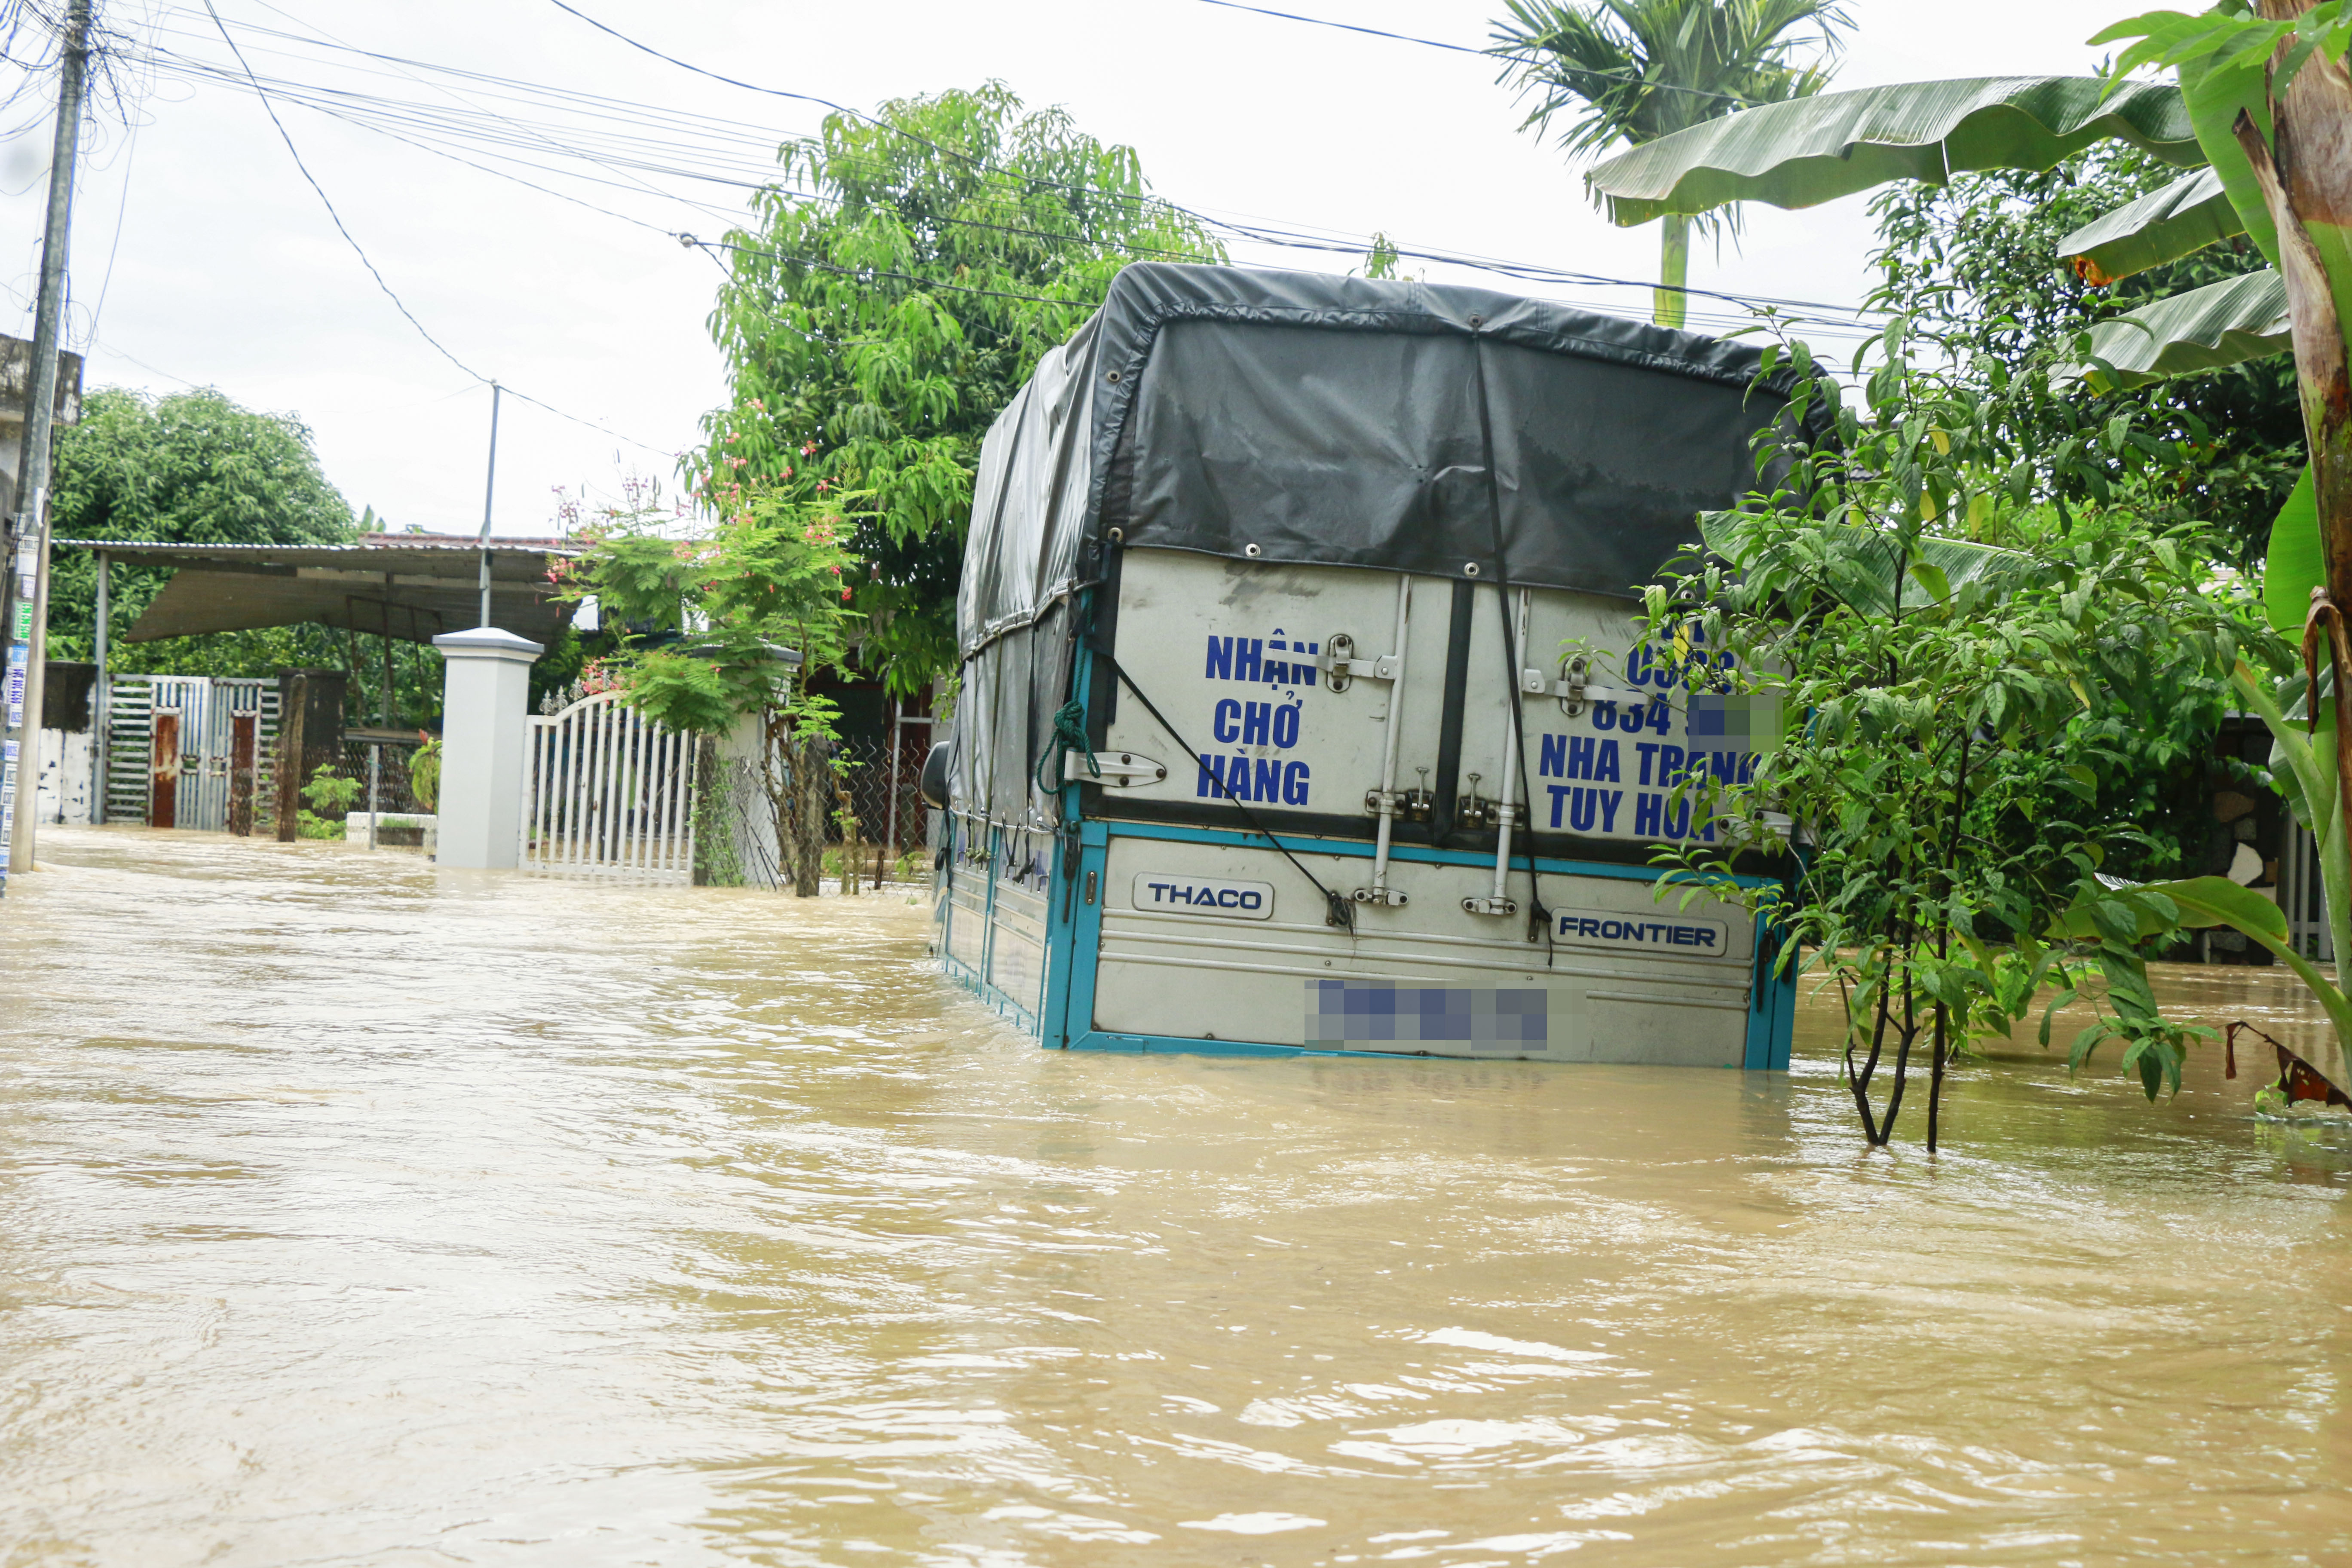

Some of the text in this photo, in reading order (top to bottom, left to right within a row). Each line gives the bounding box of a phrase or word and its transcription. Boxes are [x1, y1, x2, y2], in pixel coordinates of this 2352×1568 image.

[1206, 628, 1318, 690] NHẬN
[1213, 690, 1303, 749] CHỞ
[1592, 686, 1671, 736] 834
[1197, 748, 1310, 805] HÀNG
[1539, 733, 1620, 783] NHA
[1547, 784, 1623, 833] TUY
[1148, 882, 1262, 910] THACO
[1559, 916, 1716, 947] FRONTIER
